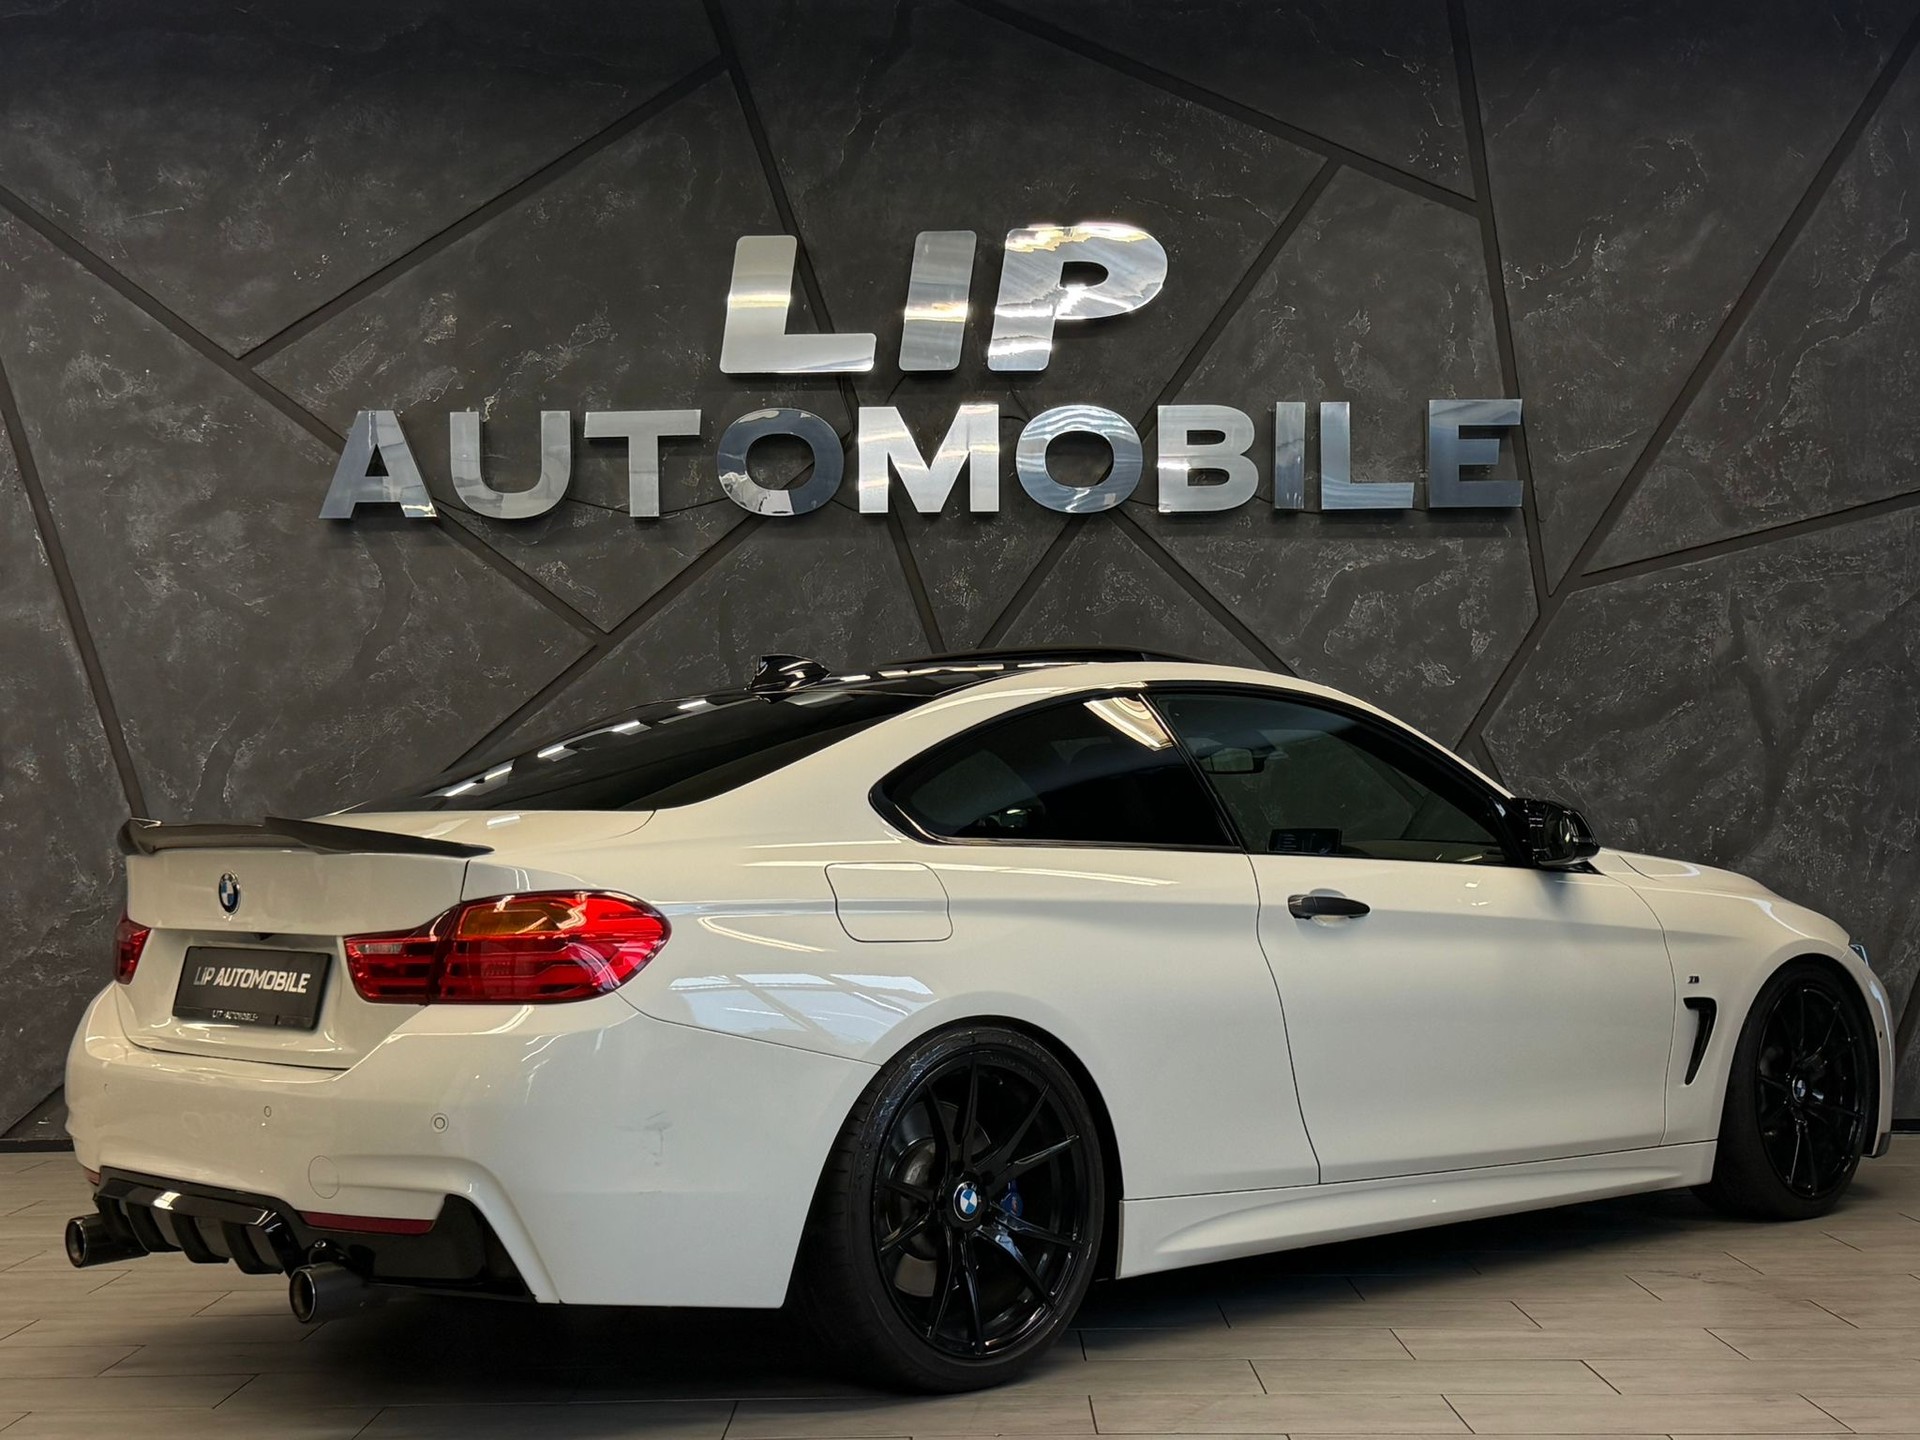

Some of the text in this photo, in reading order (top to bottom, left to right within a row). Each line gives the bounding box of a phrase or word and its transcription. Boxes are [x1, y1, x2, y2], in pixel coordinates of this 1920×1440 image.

[719, 223, 1168, 373] LIP
[319, 398, 1524, 520] AUTOMOBILE
[213, 967, 310, 993] AUTOMOBILE
